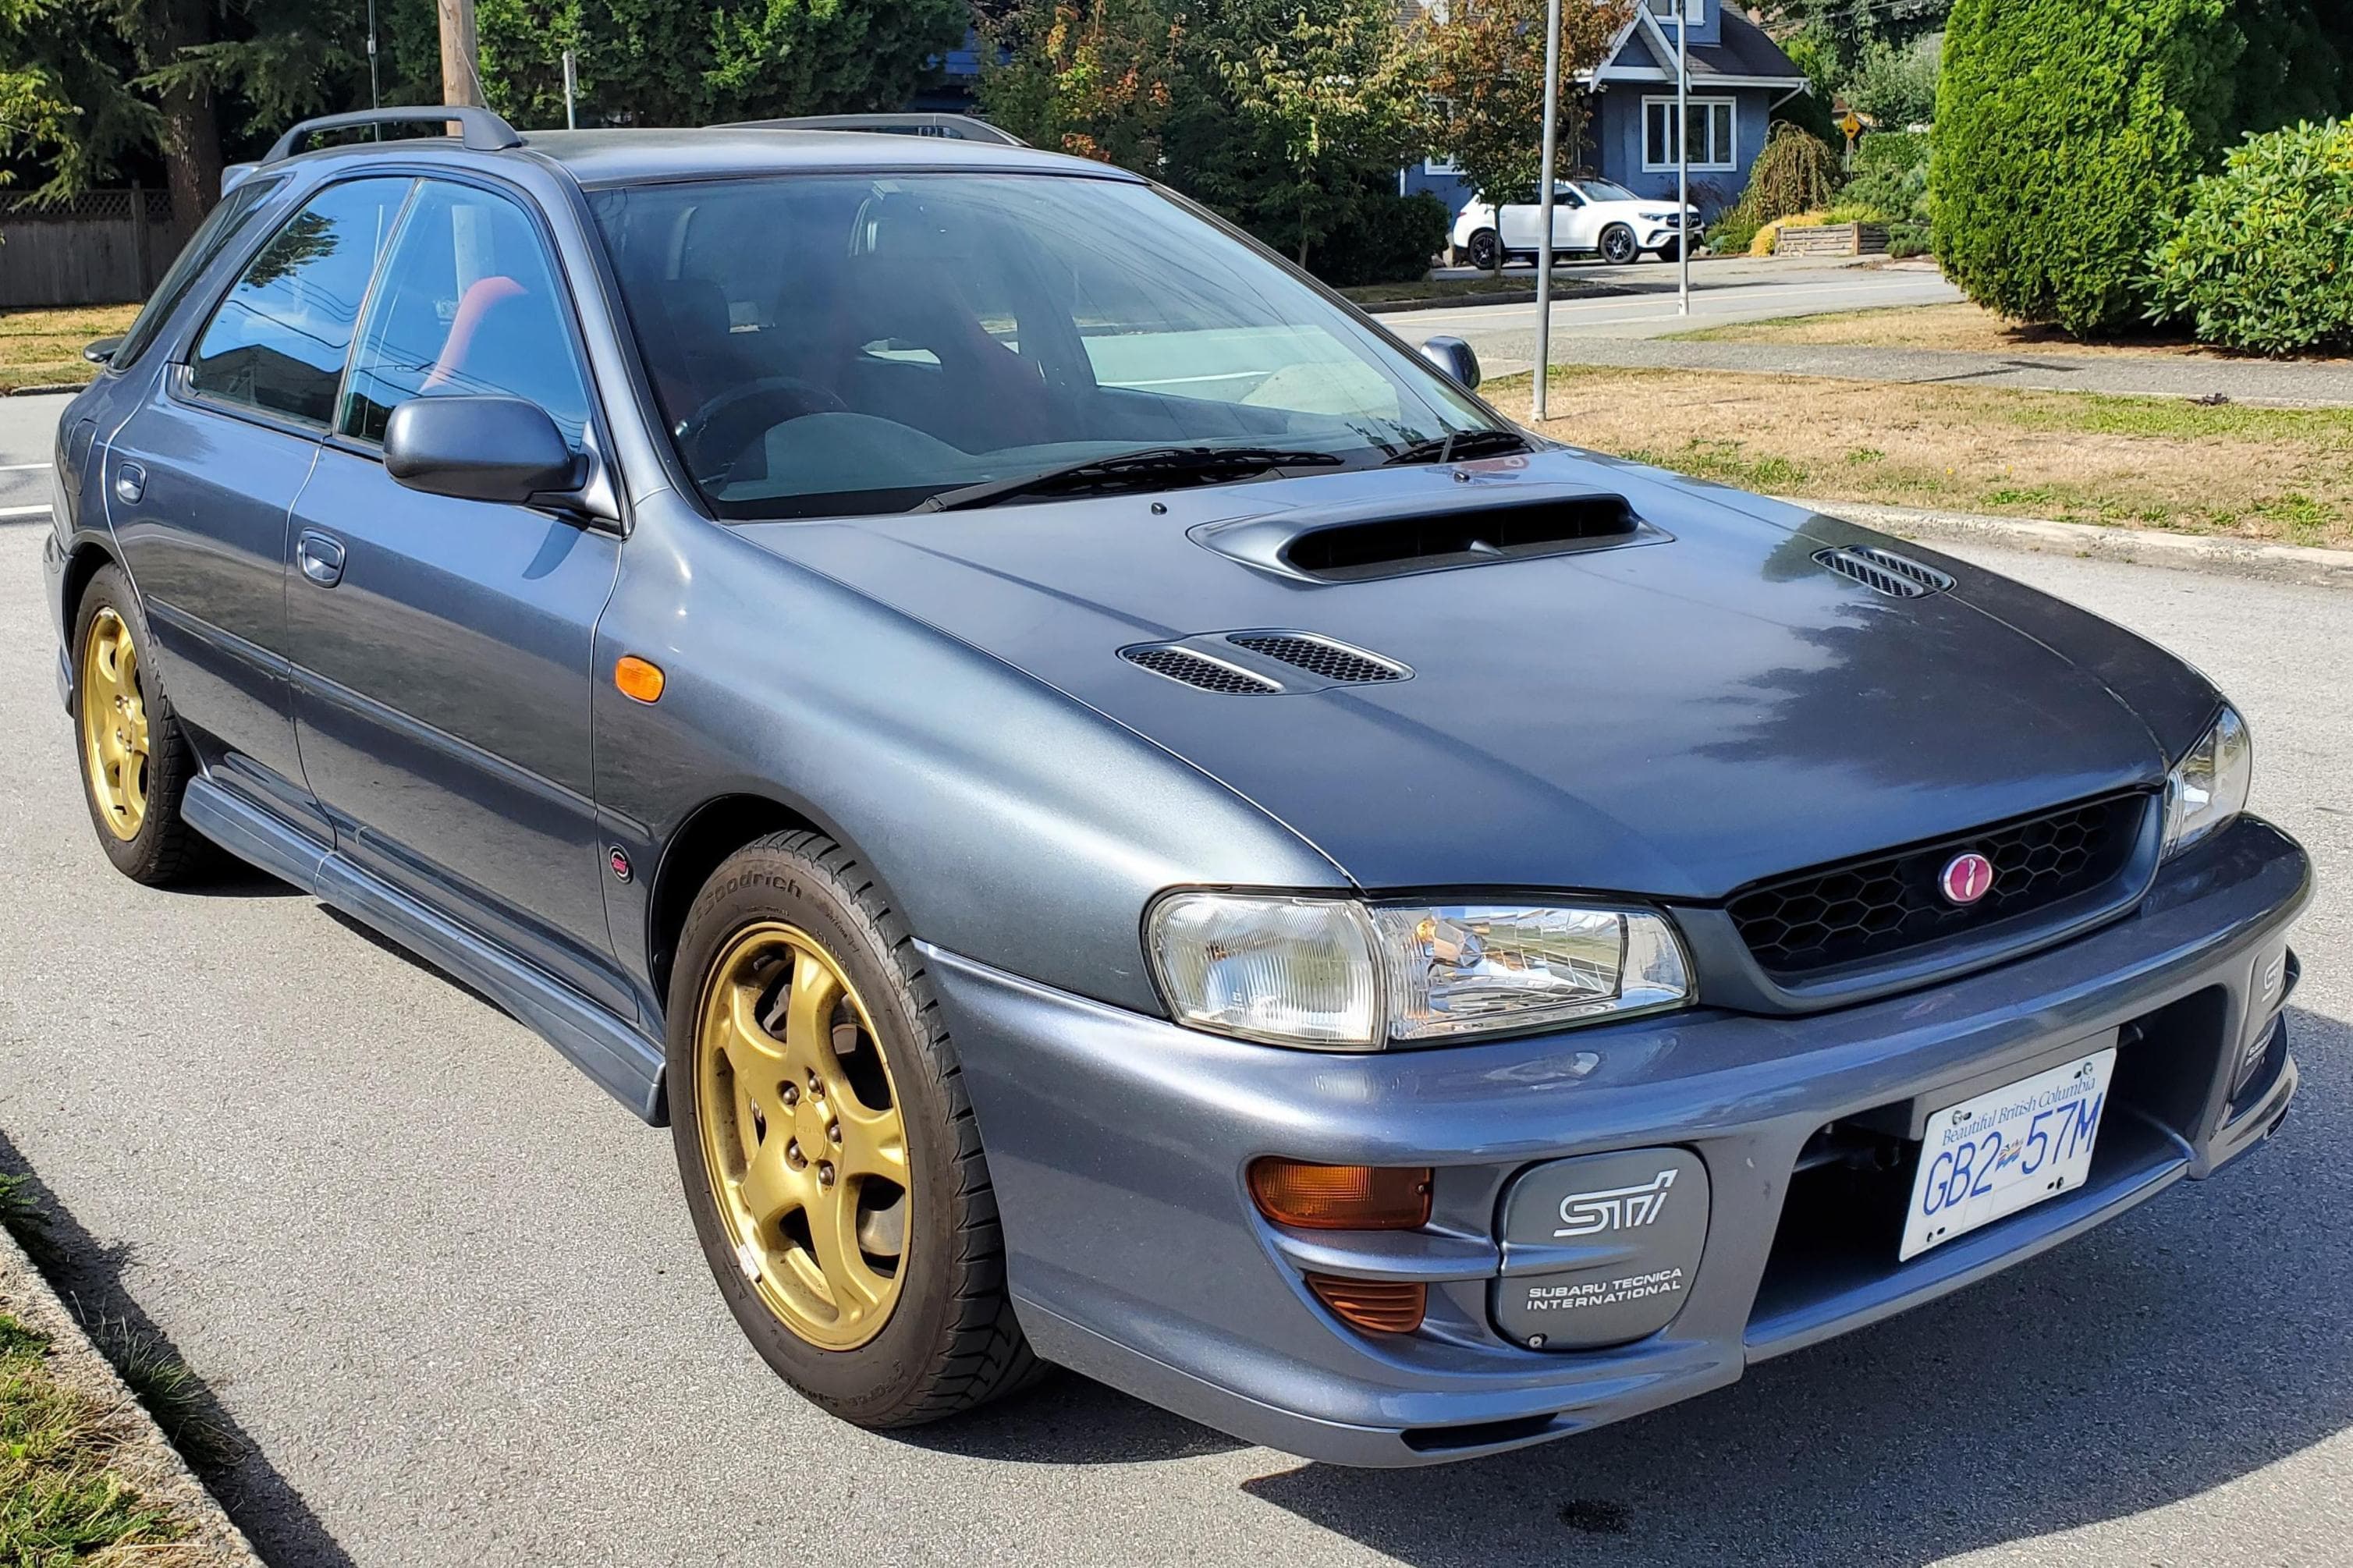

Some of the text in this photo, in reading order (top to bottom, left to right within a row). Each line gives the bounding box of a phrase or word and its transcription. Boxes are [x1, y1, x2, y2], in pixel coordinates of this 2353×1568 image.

[686, 870, 802, 950] Goodrich
[1941, 1076, 2096, 1146] Beautiful British Columbia
[1922, 1092, 2104, 1216] GB2 57M
[1526, 1279, 1682, 1311] INTERNATIONAL
[1528, 1267, 1684, 1298] SUBARU TECNICA
